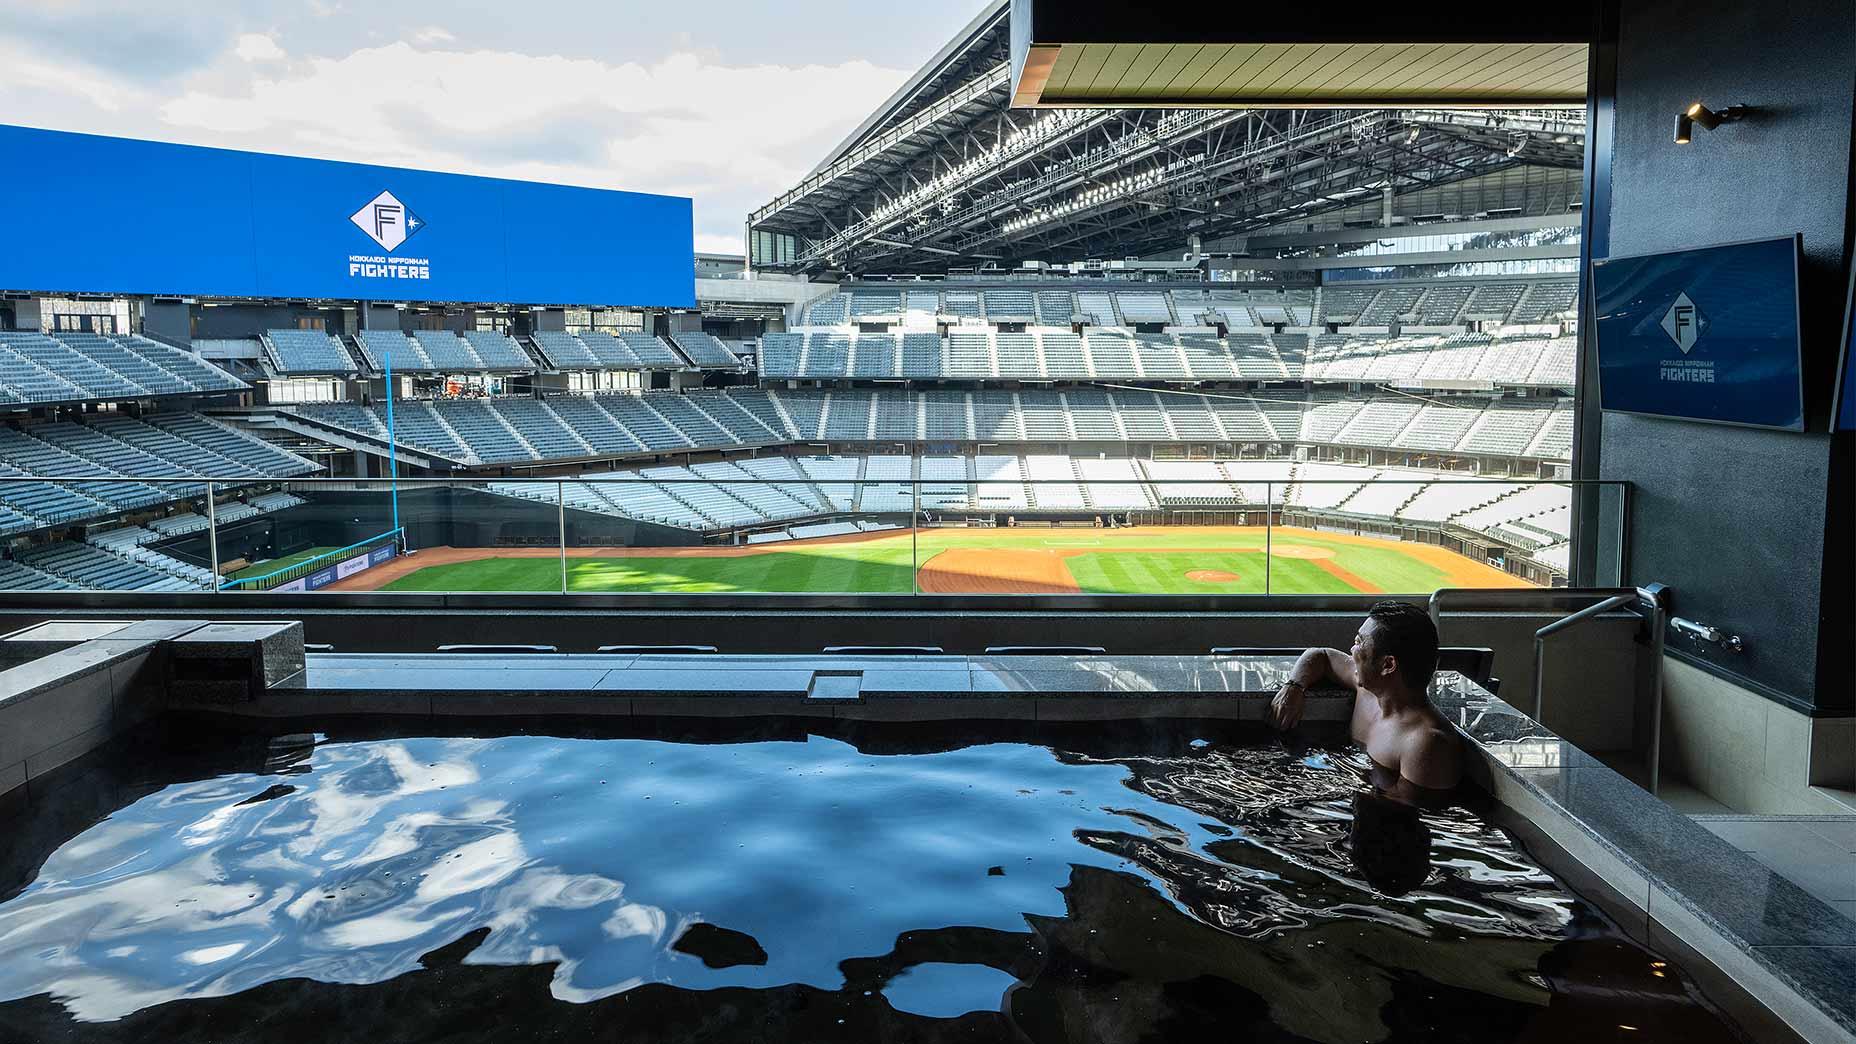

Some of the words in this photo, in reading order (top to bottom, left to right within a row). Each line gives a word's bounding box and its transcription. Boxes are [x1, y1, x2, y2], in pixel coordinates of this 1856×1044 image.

[374, 203, 401, 241] F
[349, 255, 386, 264] HOKKAIDO
[388, 256, 429, 265] NIPPONHAM
[349, 263, 430, 280] FIGHTERS
[1674, 305, 1693, 344] F
[1660, 367, 1715, 384] FIGHTERS
